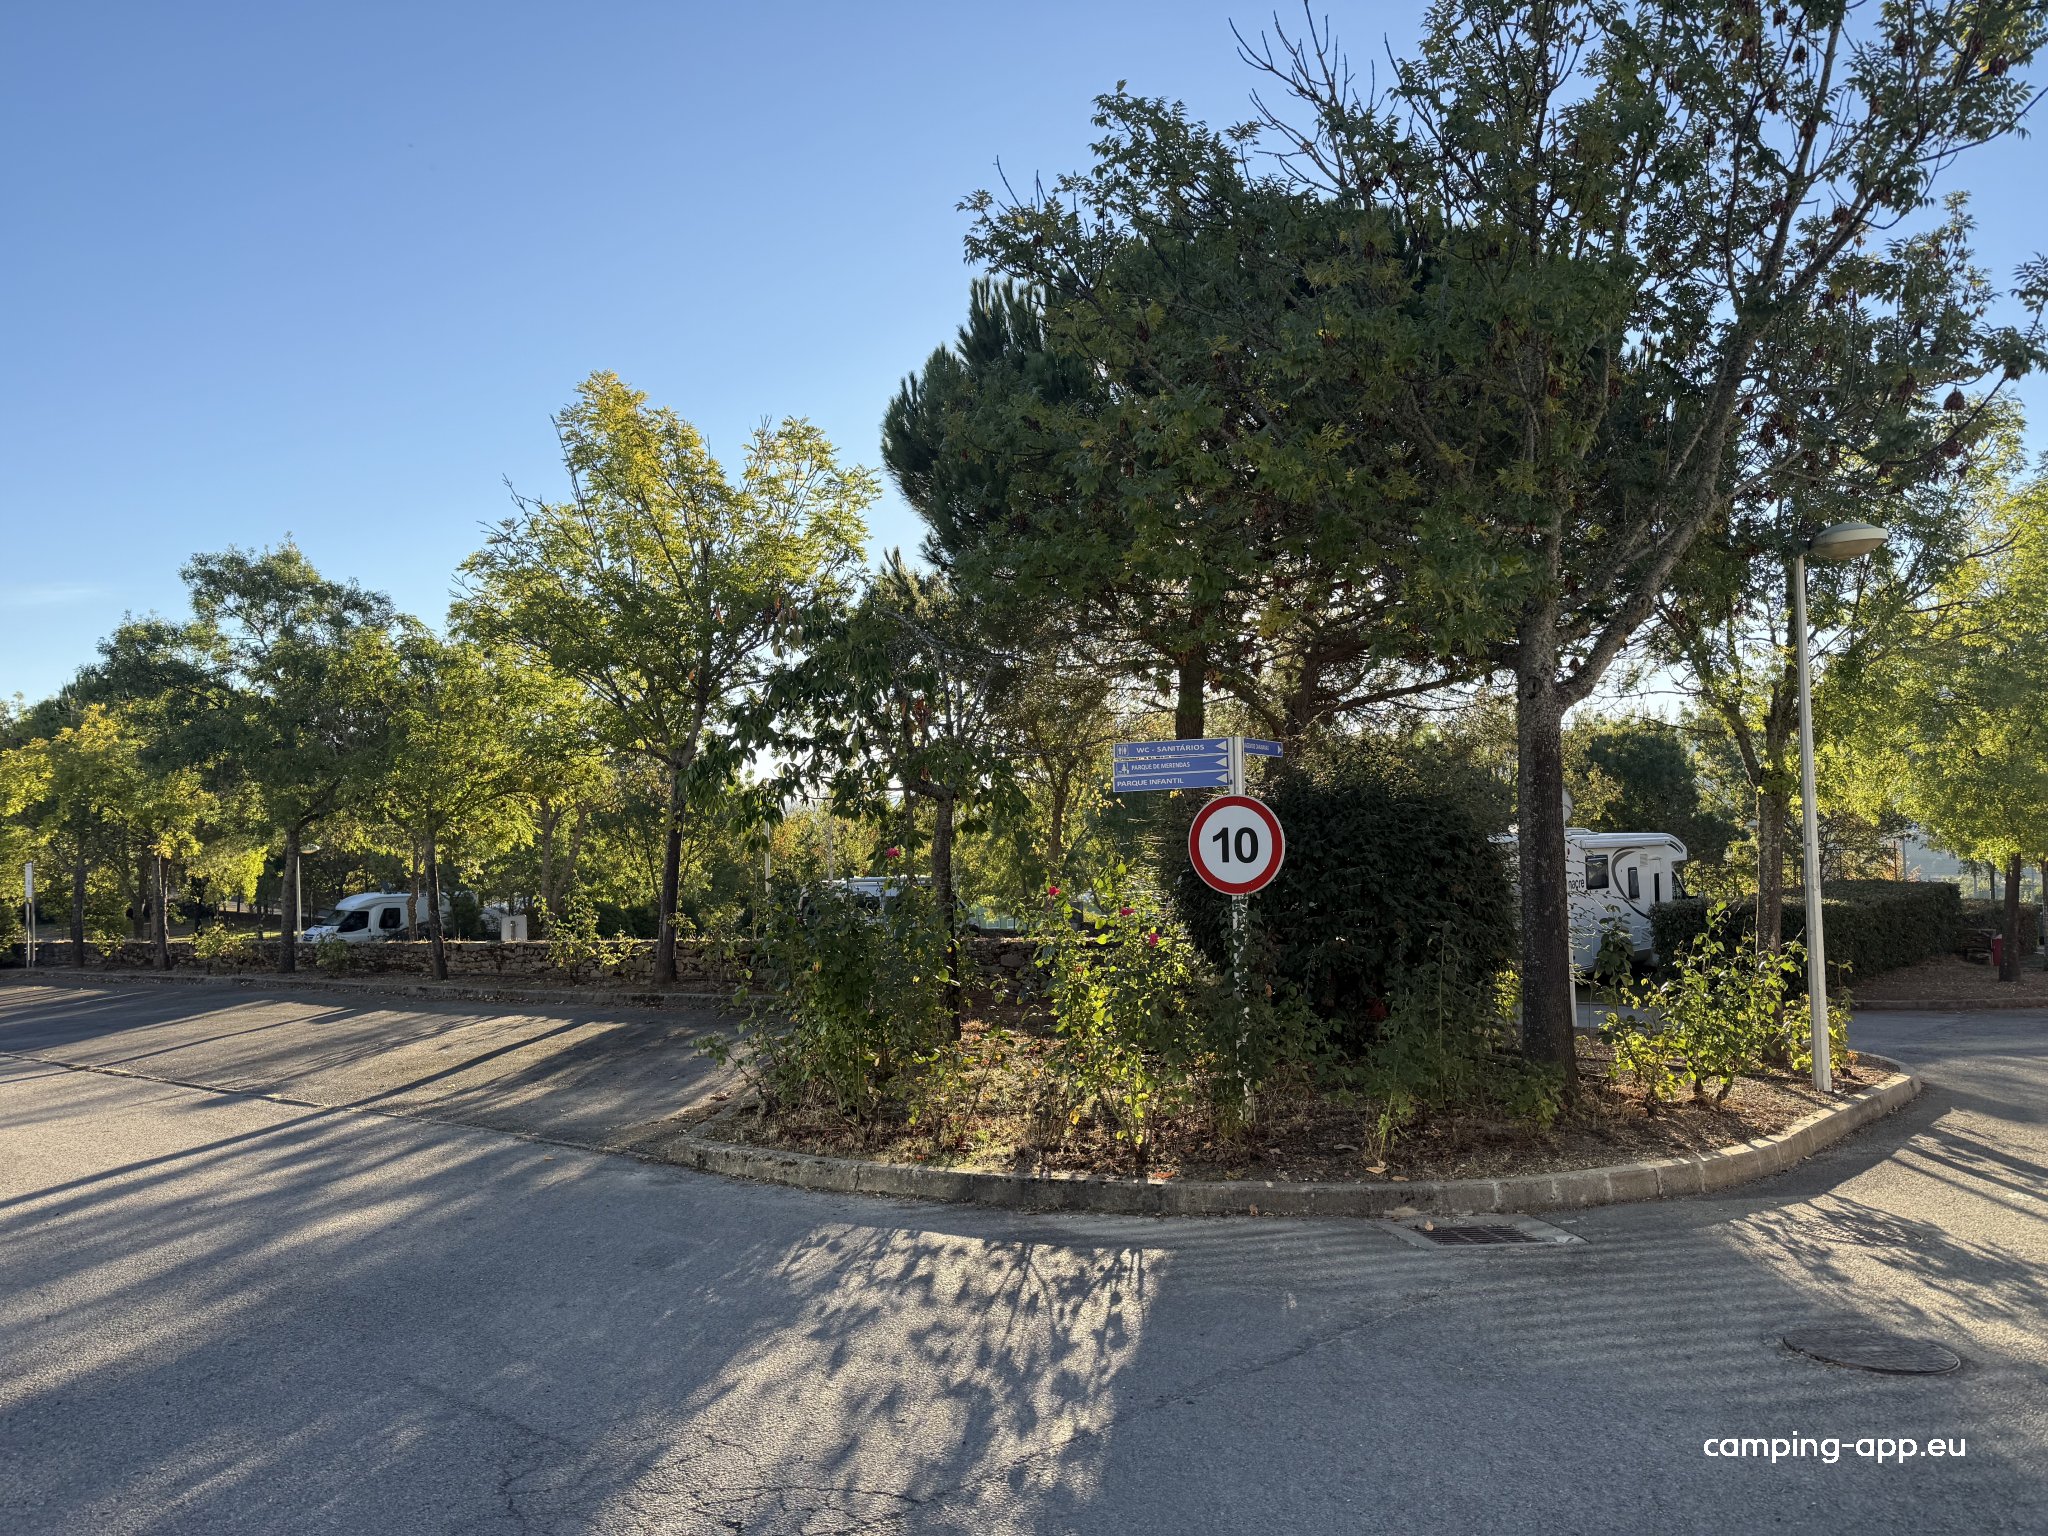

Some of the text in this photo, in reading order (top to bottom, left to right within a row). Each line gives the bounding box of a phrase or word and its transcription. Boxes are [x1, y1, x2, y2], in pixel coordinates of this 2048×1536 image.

[1157, 744, 1205, 752] SANITÁRIOS
[1131, 763, 1152, 771] PARQUE
[1161, 761, 1190, 769] MERENDAS
[1117, 777, 1184, 787] PARQUE INFANTIL
[1212, 826, 1259, 864] 10
